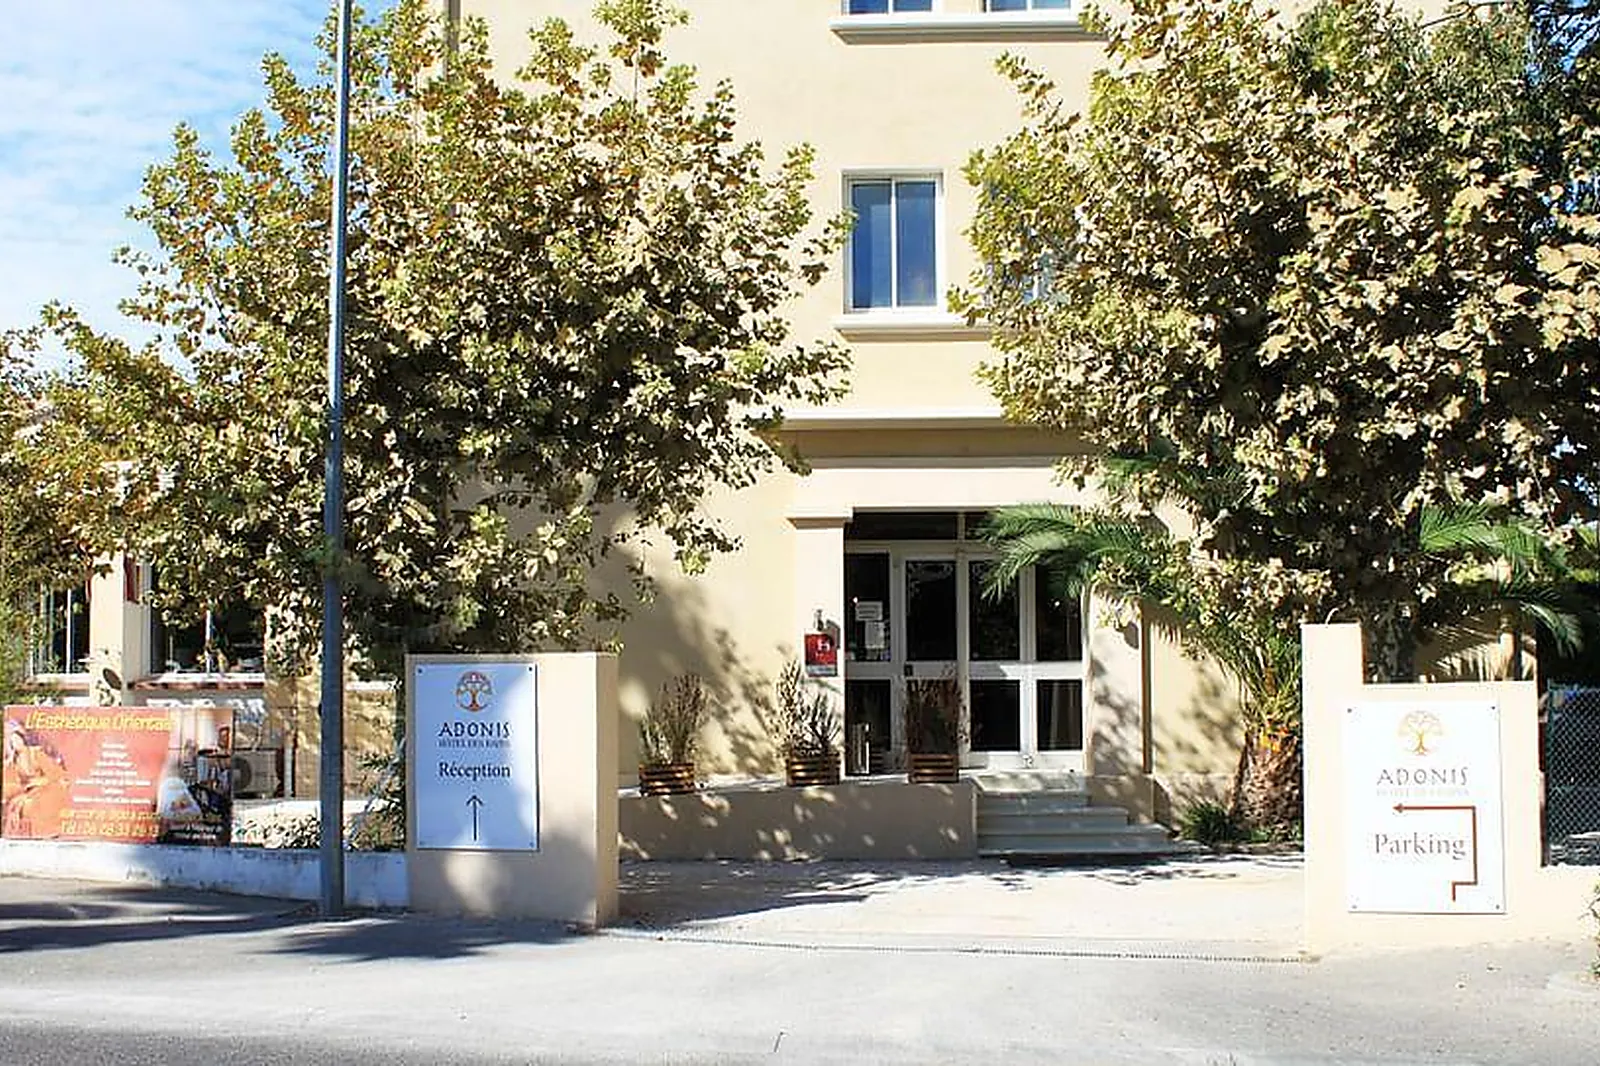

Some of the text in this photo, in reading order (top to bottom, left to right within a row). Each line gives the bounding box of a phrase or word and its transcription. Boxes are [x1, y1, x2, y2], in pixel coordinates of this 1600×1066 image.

[438, 721, 510, 738] ADONIS
[438, 760, 511, 782] Réception
[1376, 766, 1468, 786] ADONIS
[1375, 832, 1467, 861] Parking
